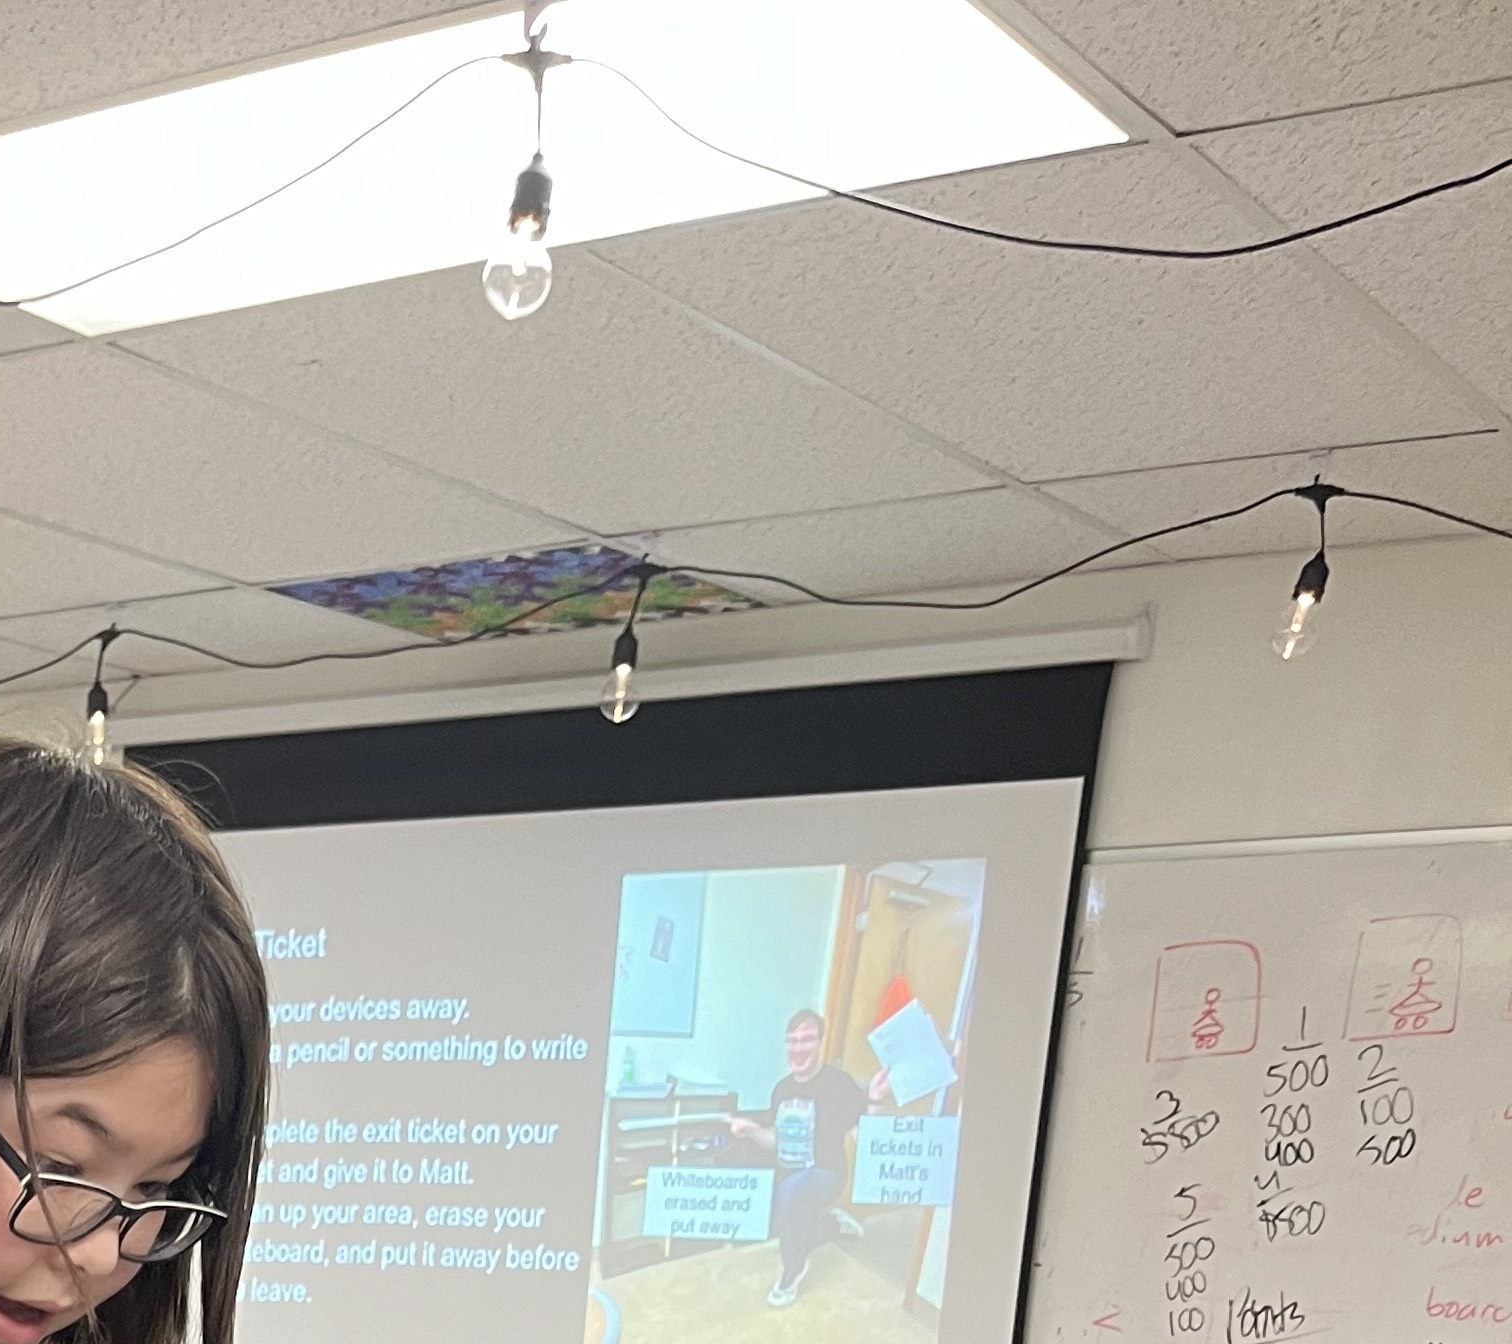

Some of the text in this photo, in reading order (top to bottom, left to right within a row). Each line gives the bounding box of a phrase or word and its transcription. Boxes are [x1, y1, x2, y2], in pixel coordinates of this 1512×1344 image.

[255, 927, 327, 960] Ticket
[269, 994, 470, 1029] your devices away.
[287, 1036, 351, 1069] pencil
[354, 1038, 377, 1063] or
[381, 1033, 499, 1067] something
[503, 1034, 526, 1062] to
[531, 1033, 589, 1062] write
[1357, 1043, 1398, 1083] 2
[1262, 1053, 1330, 1098] 500
[1153, 1089, 1182, 1125] 3
[1360, 1086, 1415, 1126] 100
[264, 1116, 559, 1151] plete the exit ticket on your
[892, 1116, 924, 1134] Exit
[870, 1138, 944, 1157] tickets in
[1264, 1137, 1315, 1167] 400
[1355, 1127, 1417, 1167] 500
[278, 1157, 319, 1184] and
[323, 1157, 368, 1190] give
[372, 1156, 387, 1184] it
[392, 1157, 414, 1184] to
[419, 1157, 475, 1185] Matt.
[661, 1171, 758, 1189] Whiteboards
[879, 1163, 929, 1181] Matt's
[664, 1194, 751, 1213] erased and
[880, 1186, 923, 1204] hand
[1173, 1183, 1202, 1222] 5
[279, 1203, 307, 1229] up
[312, 1202, 359, 1230] your
[363, 1203, 418, 1229] area,
[425, 1205, 489, 1228] erase
[494, 1204, 547, 1234] your
[671, 1218, 740, 1238] put away
[335, 1239, 376, 1265] and
[380, 1241, 417, 1270] put
[422, 1240, 436, 1266] it
[441, 1247, 501, 1275] away
[505, 1242, 581, 1273] before
[1163, 1235, 1216, 1280] 500
[251, 1276, 313, 1305] leave.
[1165, 1270, 1207, 1303] 400
[1169, 1306, 1205, 1337] 100
